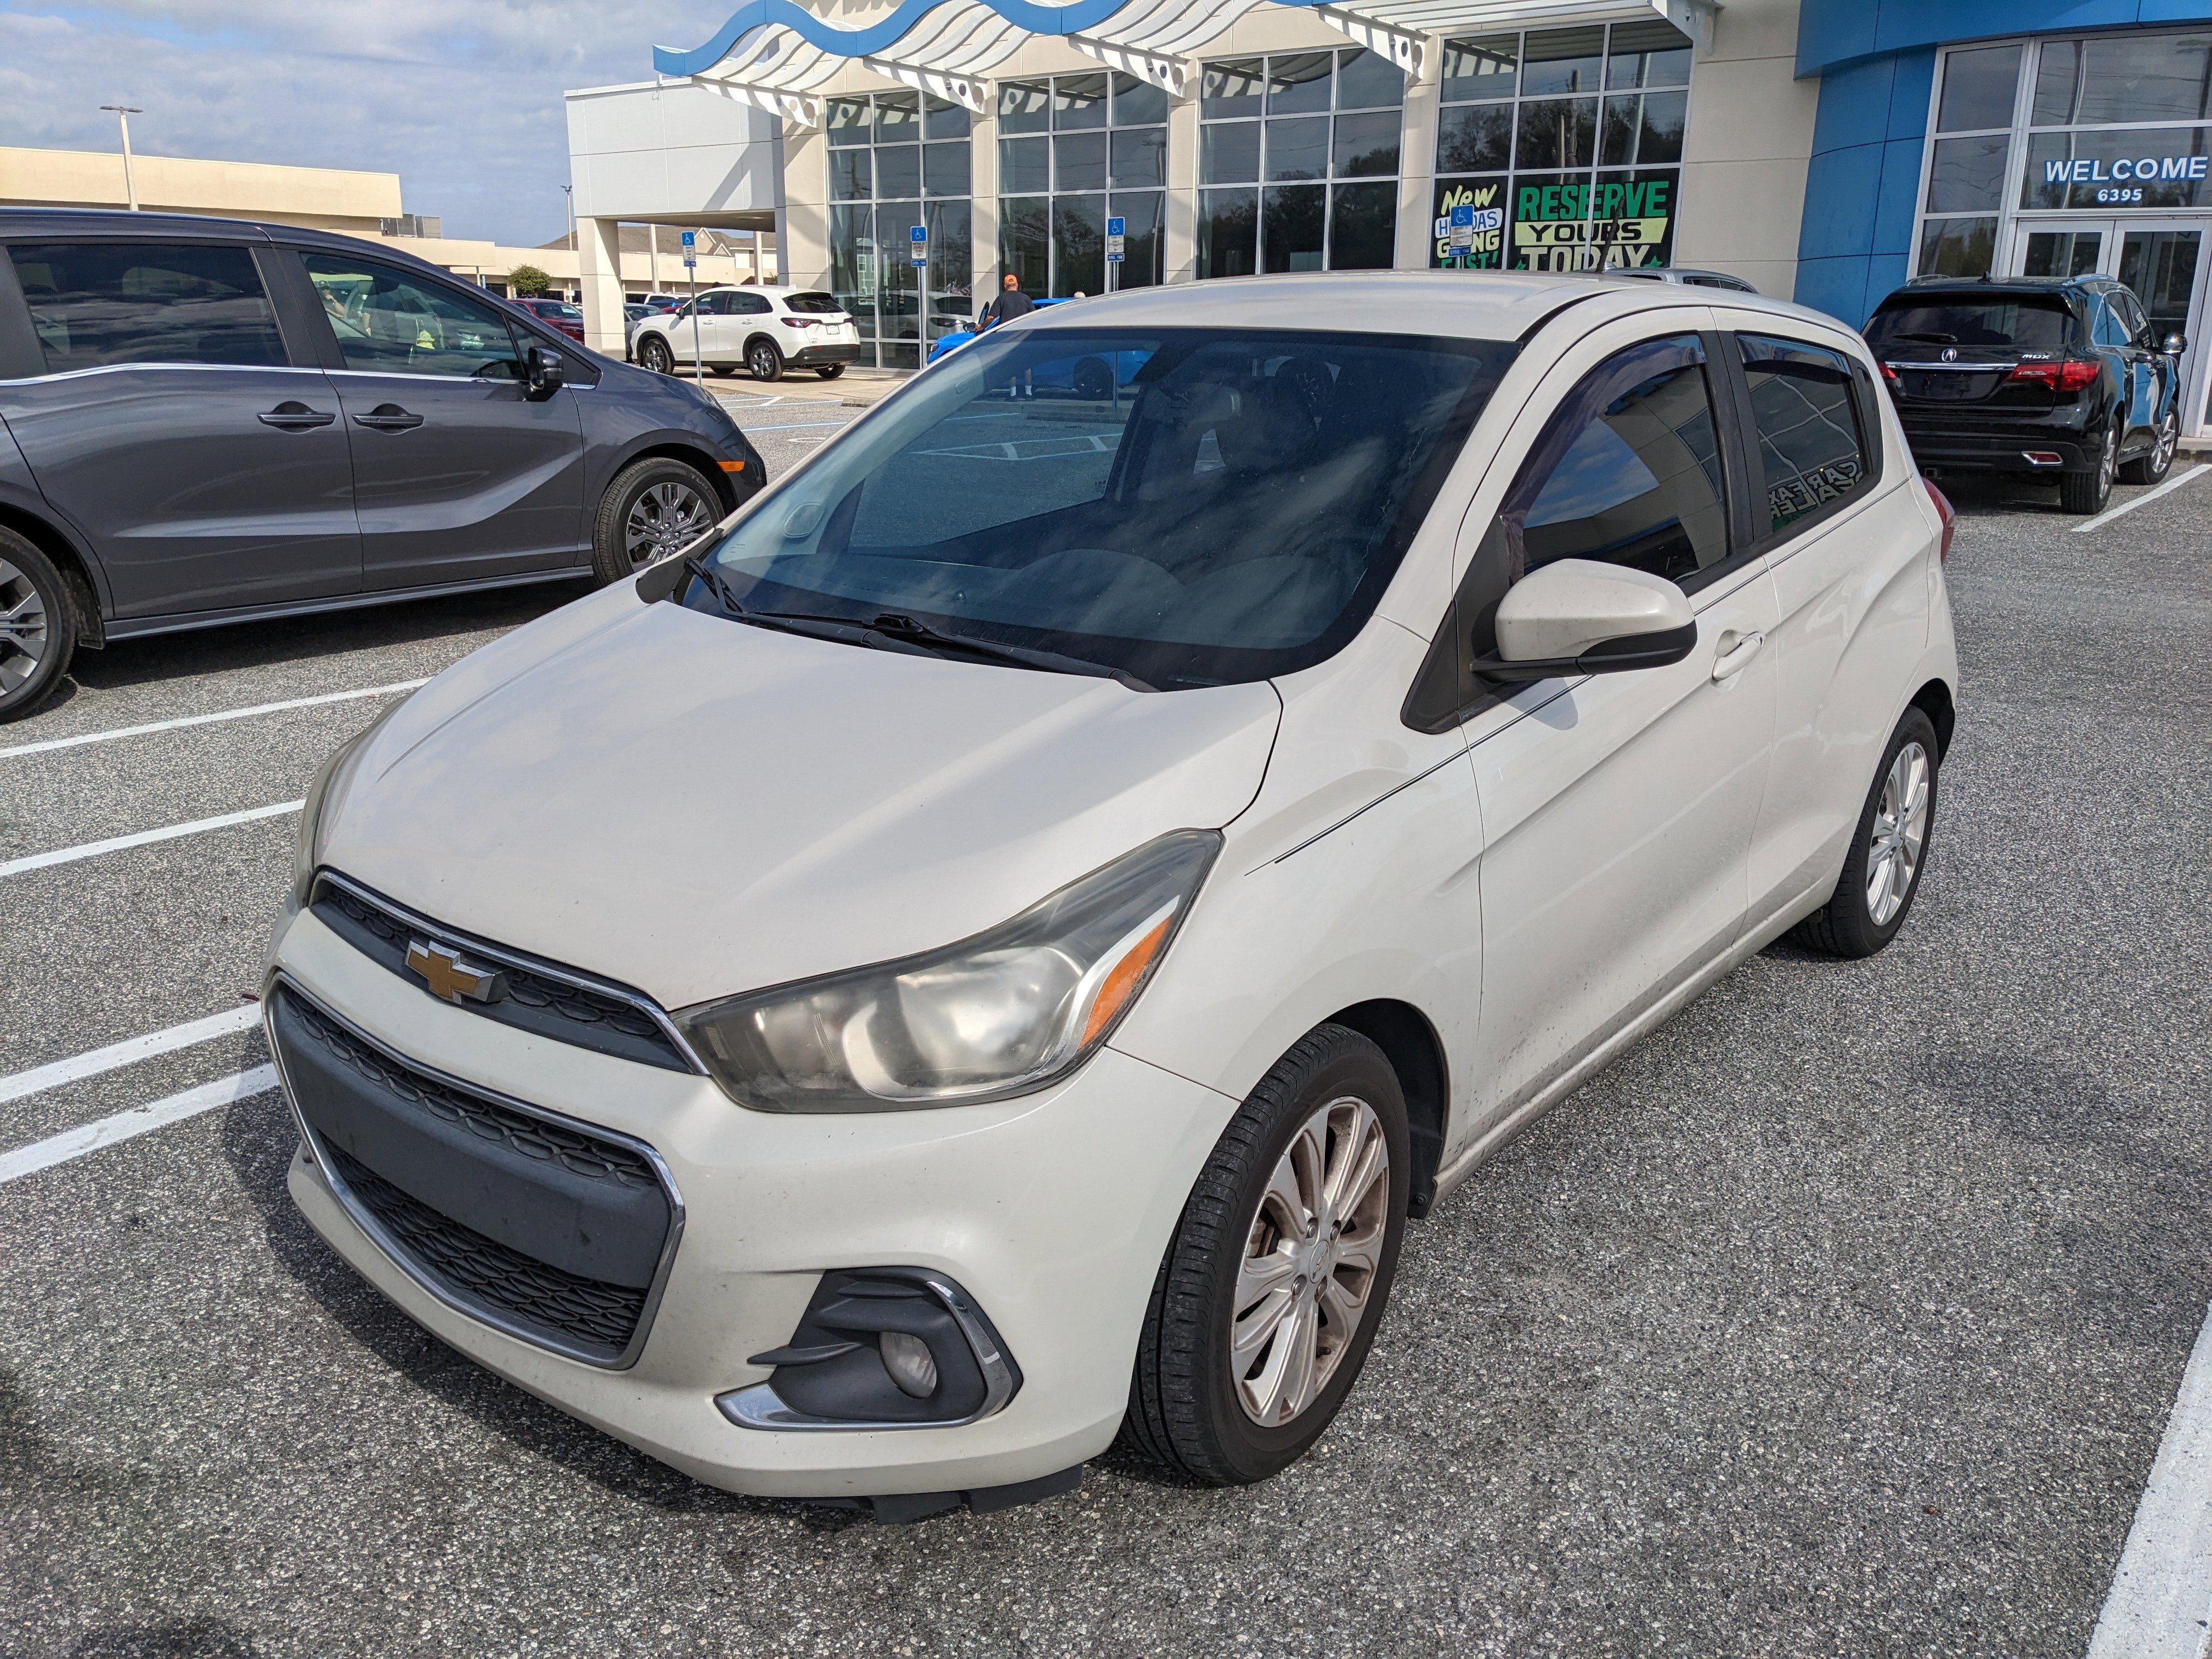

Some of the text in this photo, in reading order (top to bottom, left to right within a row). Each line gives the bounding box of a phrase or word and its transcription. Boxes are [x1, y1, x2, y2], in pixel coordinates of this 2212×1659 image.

[2046, 156, 2209, 182] WELCOME
[1517, 181, 1669, 220] RESERVE
[2097, 188, 2142, 201] 6395
[1439, 211, 1497, 235] HAS
[1528, 222, 1641, 242] YOURS
[1437, 229, 1500, 258] GNG
[1521, 245, 1650, 272] TODAY
